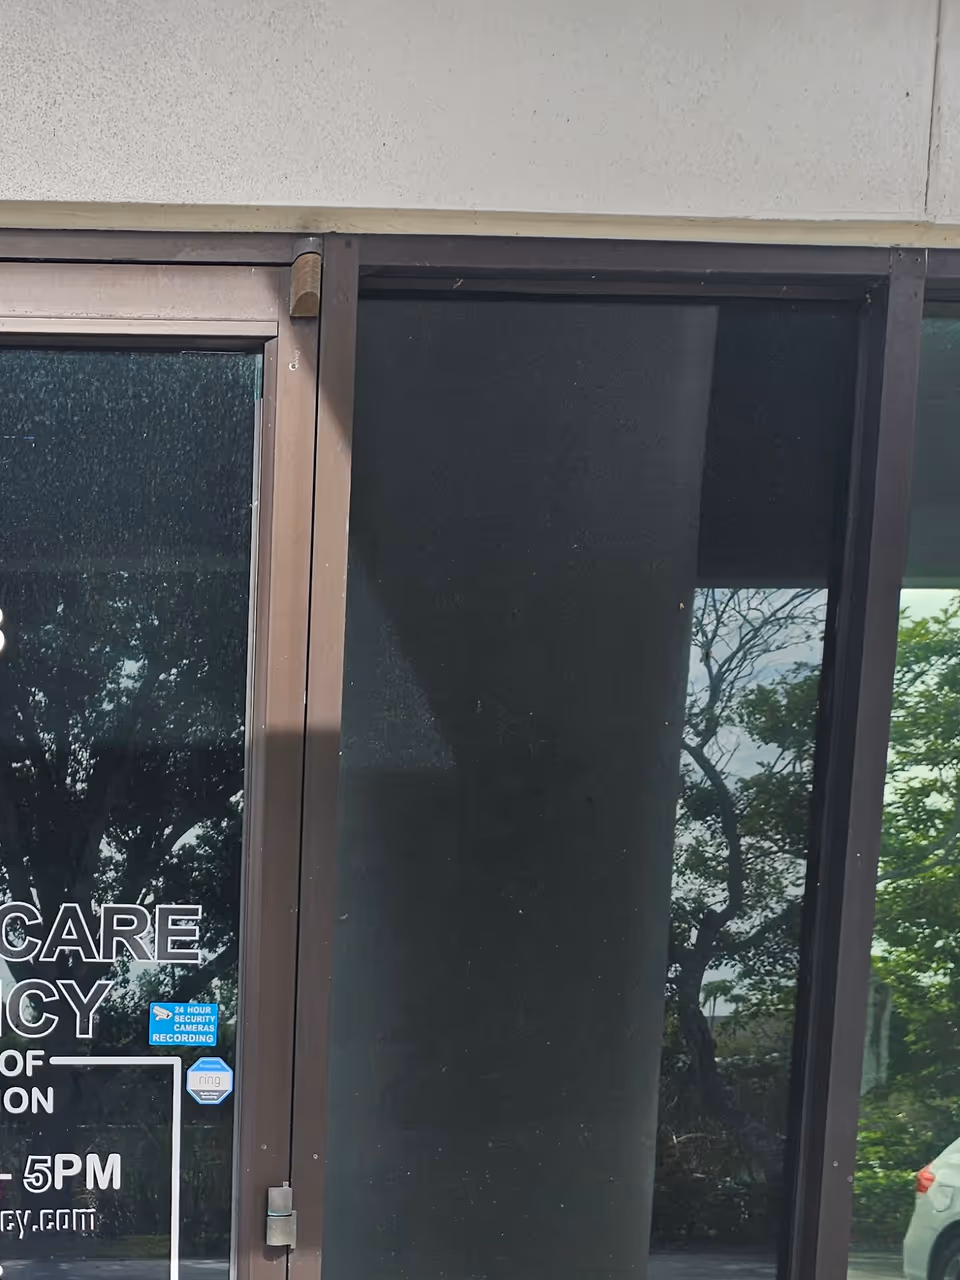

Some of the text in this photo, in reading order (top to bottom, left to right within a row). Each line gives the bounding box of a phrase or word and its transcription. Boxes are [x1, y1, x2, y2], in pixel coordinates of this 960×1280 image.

[174, 1006, 212, 1014] 24 HOUR
[174, 1015, 216, 1023] SECURITY
[173, 1024, 215, 1032] CAMERAS
[152, 1033, 214, 1043] RECORDING
[198, 1073, 221, 1088] ring
[23, 1152, 121, 1194] 5PM
